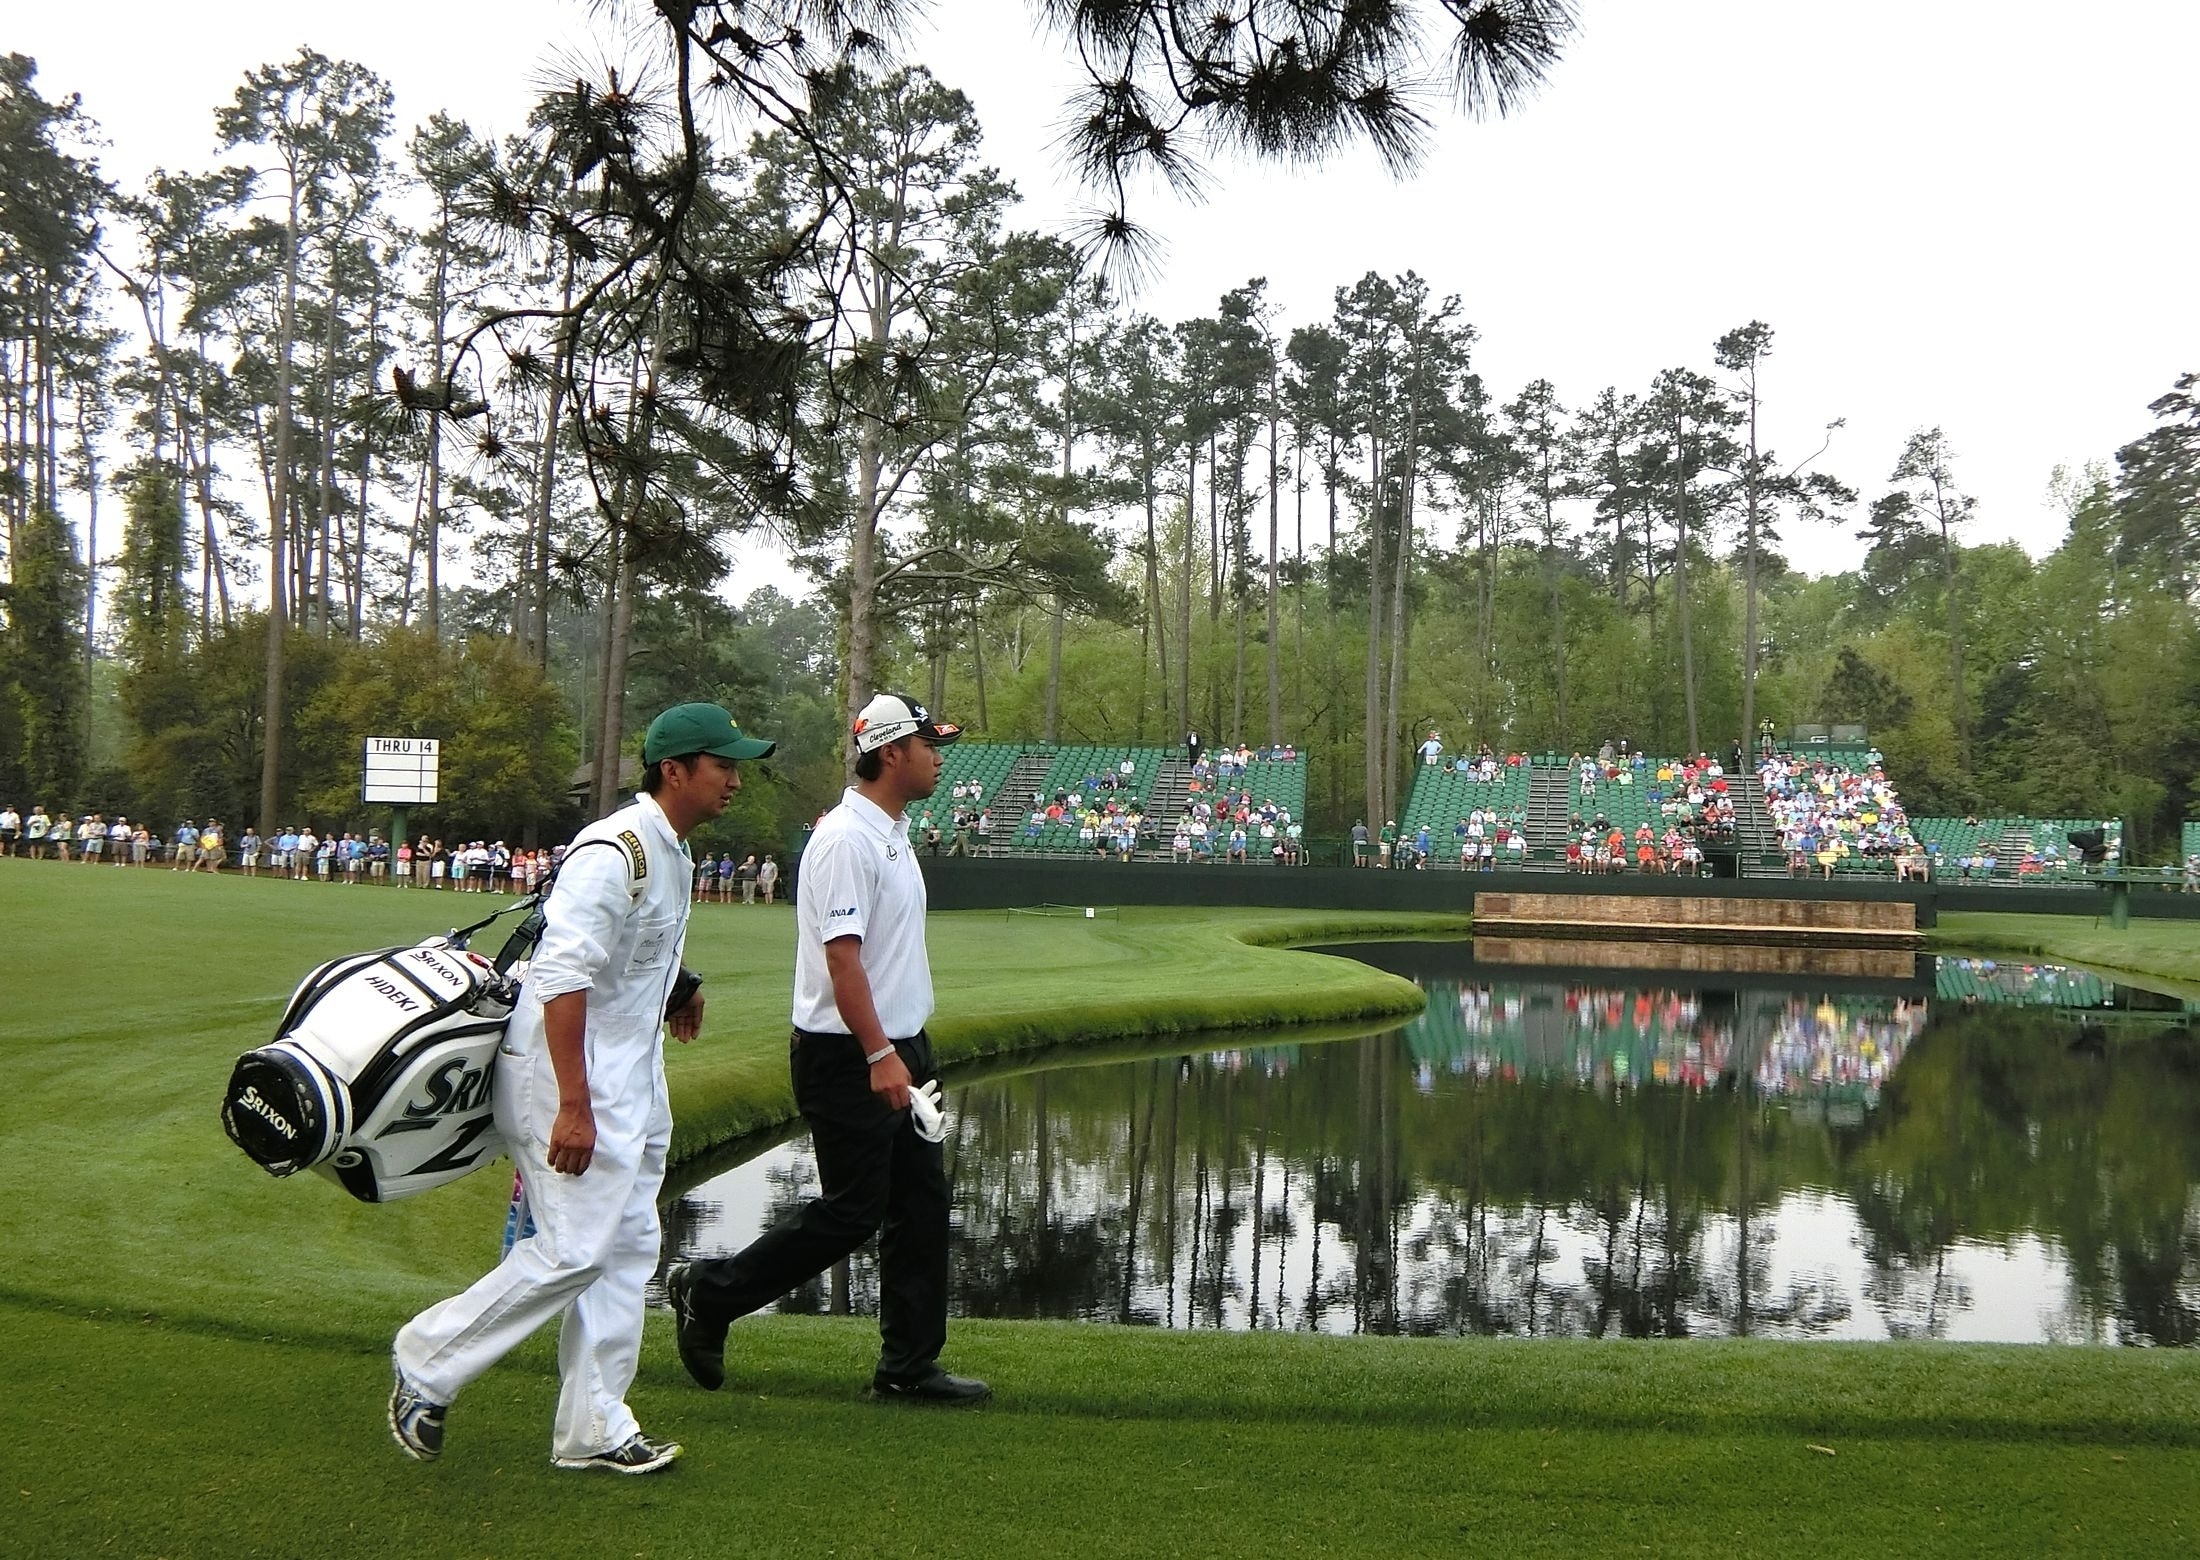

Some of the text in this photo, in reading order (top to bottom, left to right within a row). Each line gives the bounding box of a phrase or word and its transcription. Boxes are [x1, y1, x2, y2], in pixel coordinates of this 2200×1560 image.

[374, 739, 432, 753] THRU 14
[870, 722, 902, 743] Cleveland
[829, 908, 847, 918] ANA
[413, 950, 464, 987] SRIXON
[364, 976, 420, 1012] HIDEKI
[402, 1056, 495, 1118] SRI
[240, 1086, 297, 1140] SRIXON
